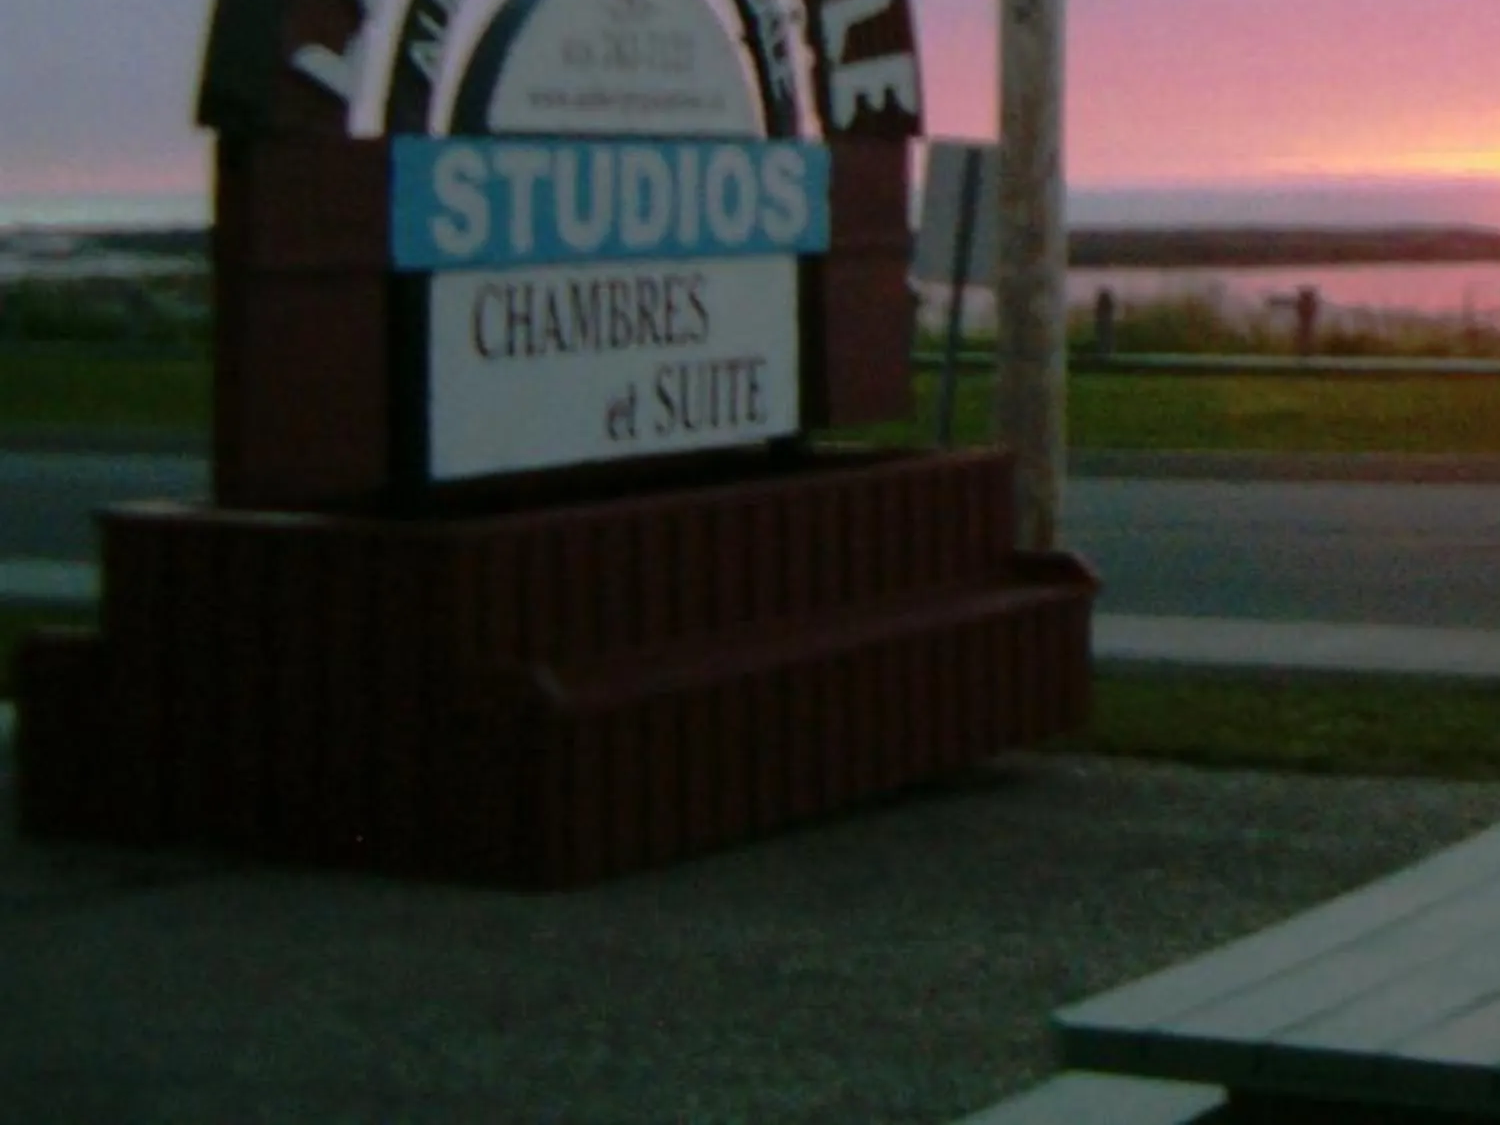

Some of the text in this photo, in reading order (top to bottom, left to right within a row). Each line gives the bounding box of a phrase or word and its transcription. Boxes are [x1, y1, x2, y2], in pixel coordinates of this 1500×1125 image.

[429, 146, 808, 256] STUDIOS
[471, 275, 711, 360] CHAMBRES
[606, 358, 768, 442] et SUITE
